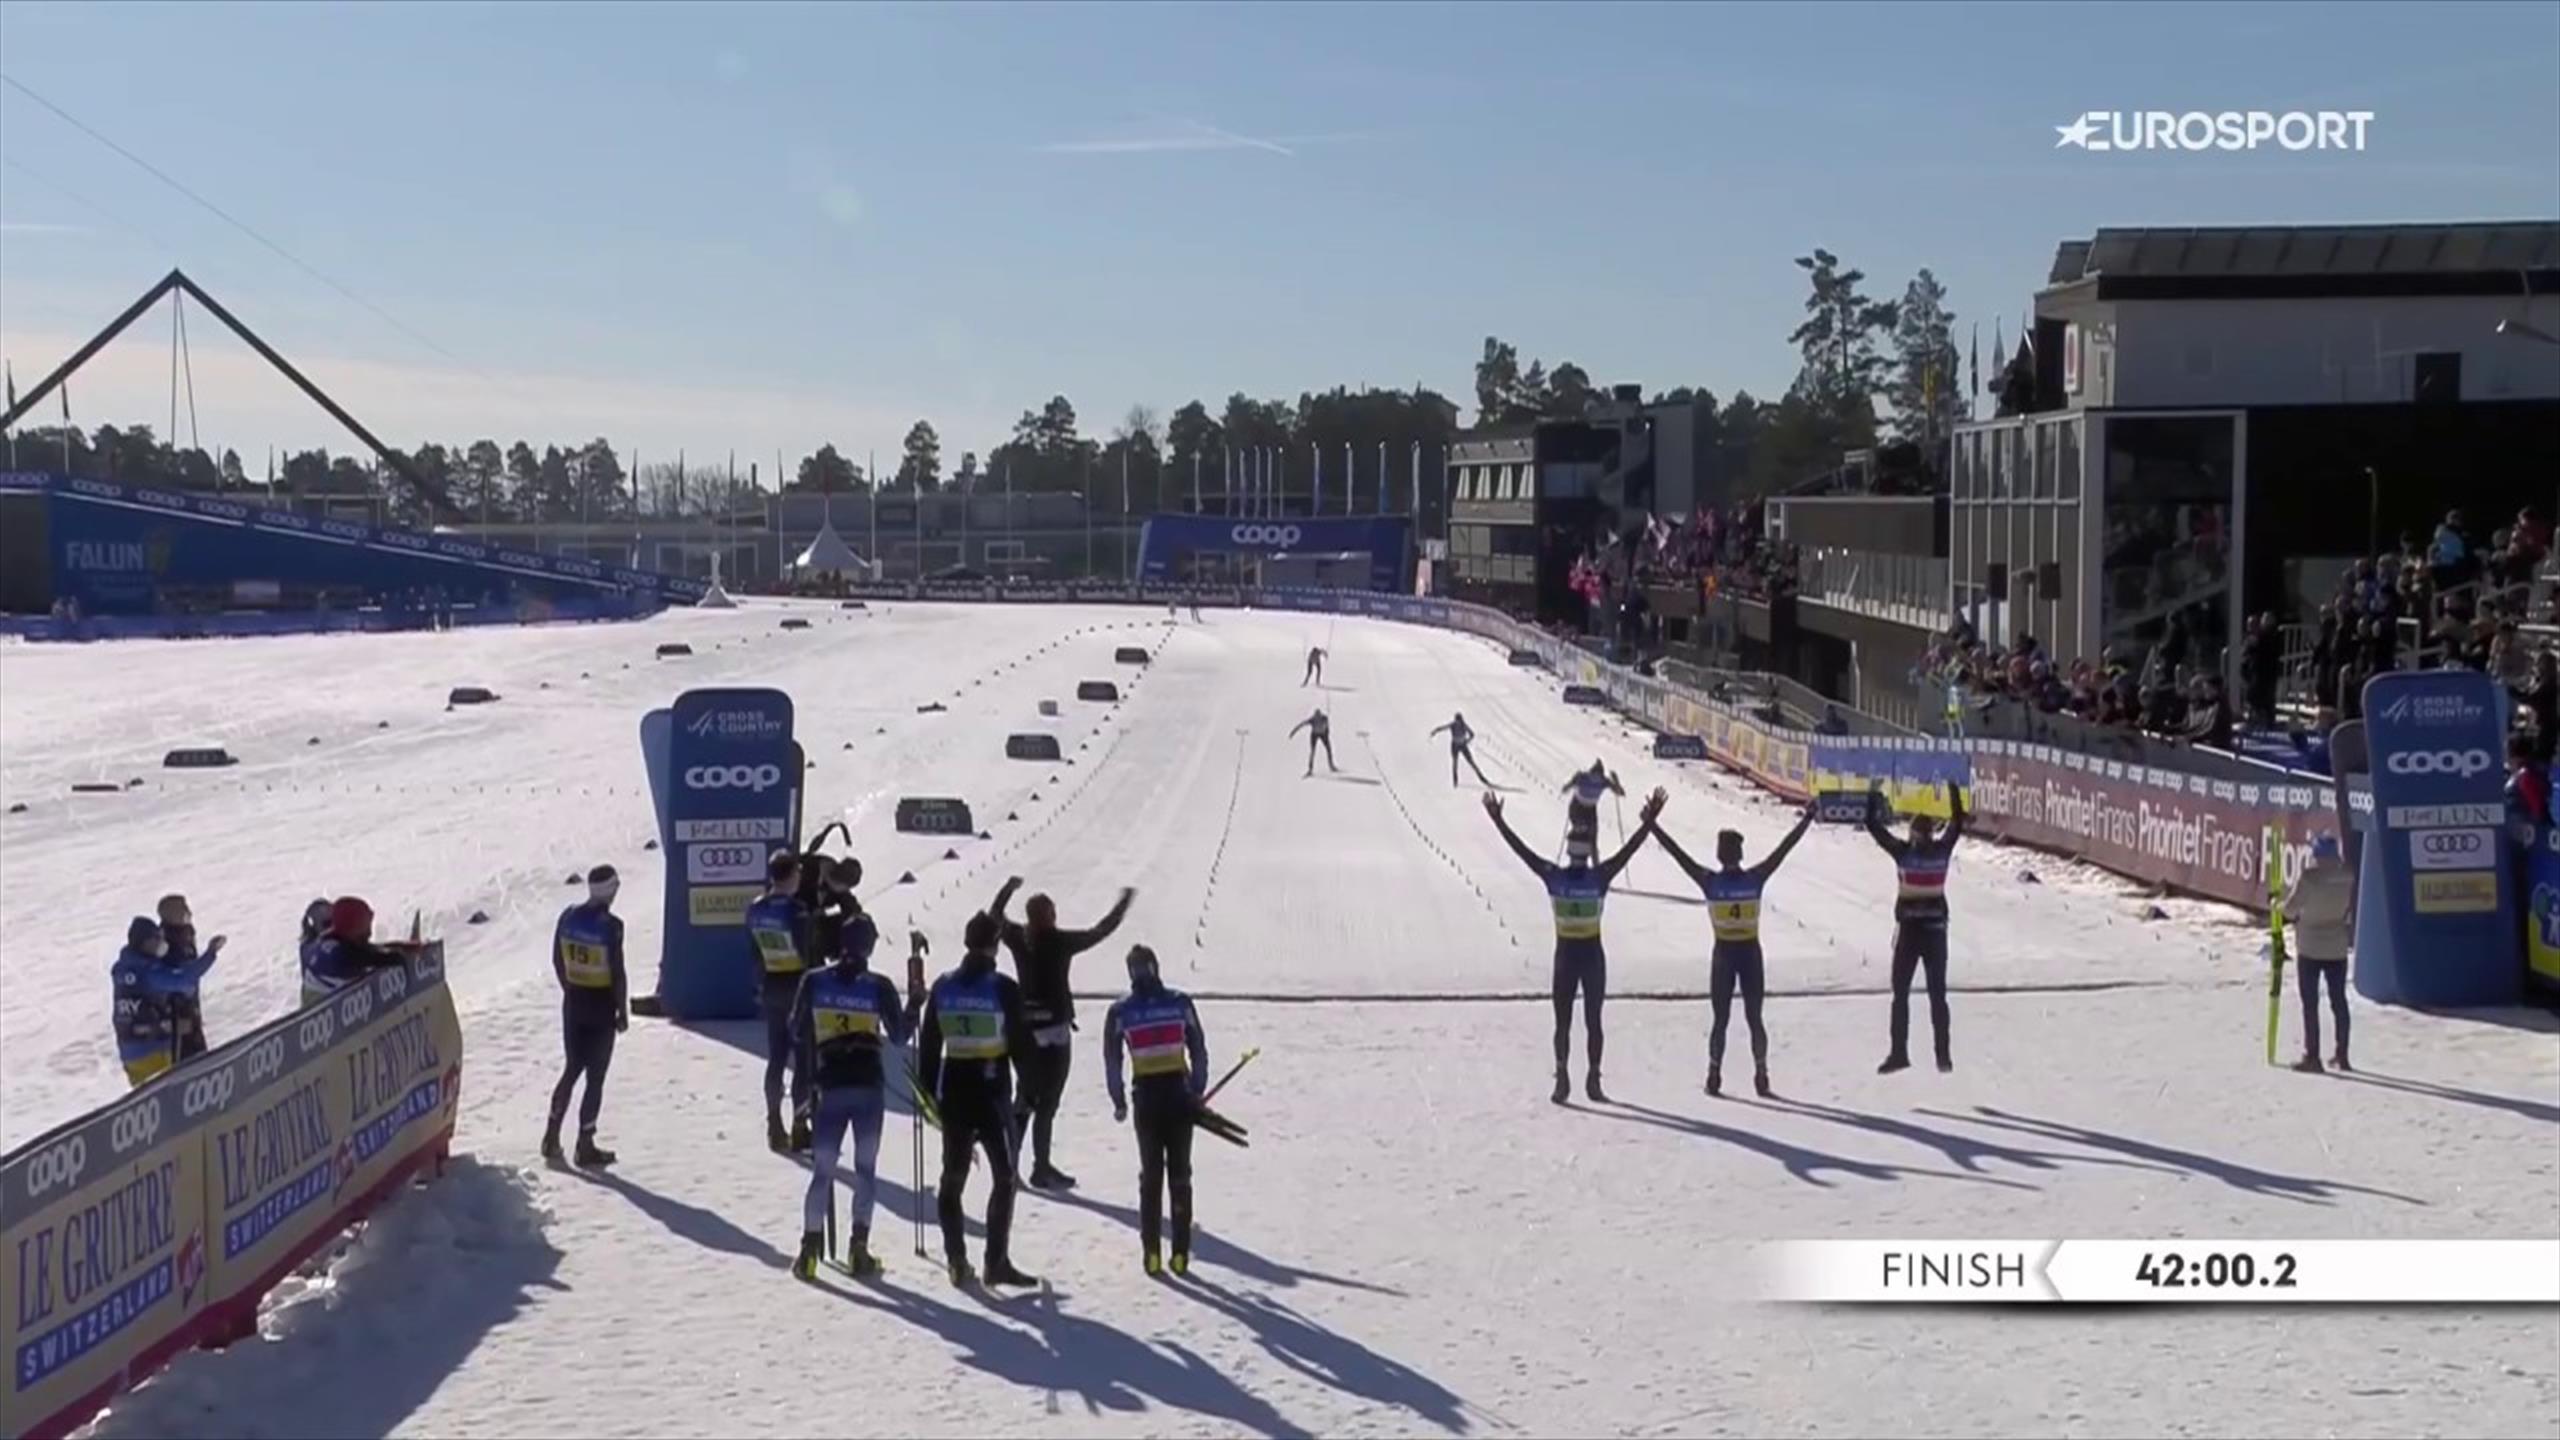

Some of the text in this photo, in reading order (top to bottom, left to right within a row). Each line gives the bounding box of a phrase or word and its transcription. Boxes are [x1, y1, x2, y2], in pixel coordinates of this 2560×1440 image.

[66, 542, 144, 570] FALUN
[1231, 524, 1301, 548] coop
[685, 763, 781, 792] coop
[2387, 748, 2491, 778] coop
[2138, 800, 2201, 865] Prioritet
[2202, 813, 2254, 881] Finans
[1729, 903, 1741, 919] 4
[836, 1014, 849, 1032] 3
[956, 1014, 971, 1035] 3
[28, 1135, 86, 1197] coop
[111, 1096, 160, 1152] coop
[183, 1066, 235, 1115] coop
[249, 1036, 284, 1079] coop
[301, 1008, 333, 1051] coop
[341, 984, 373, 1026] coop
[348, 1047, 370, 1122] LE
[217, 1125, 250, 1210] LE
[230, 1165, 330, 1251] SWITZERLAND
[17, 1161, 175, 1333] LE GRUYÈRE
[25, 1264, 170, 1379] SWITZERLAND
